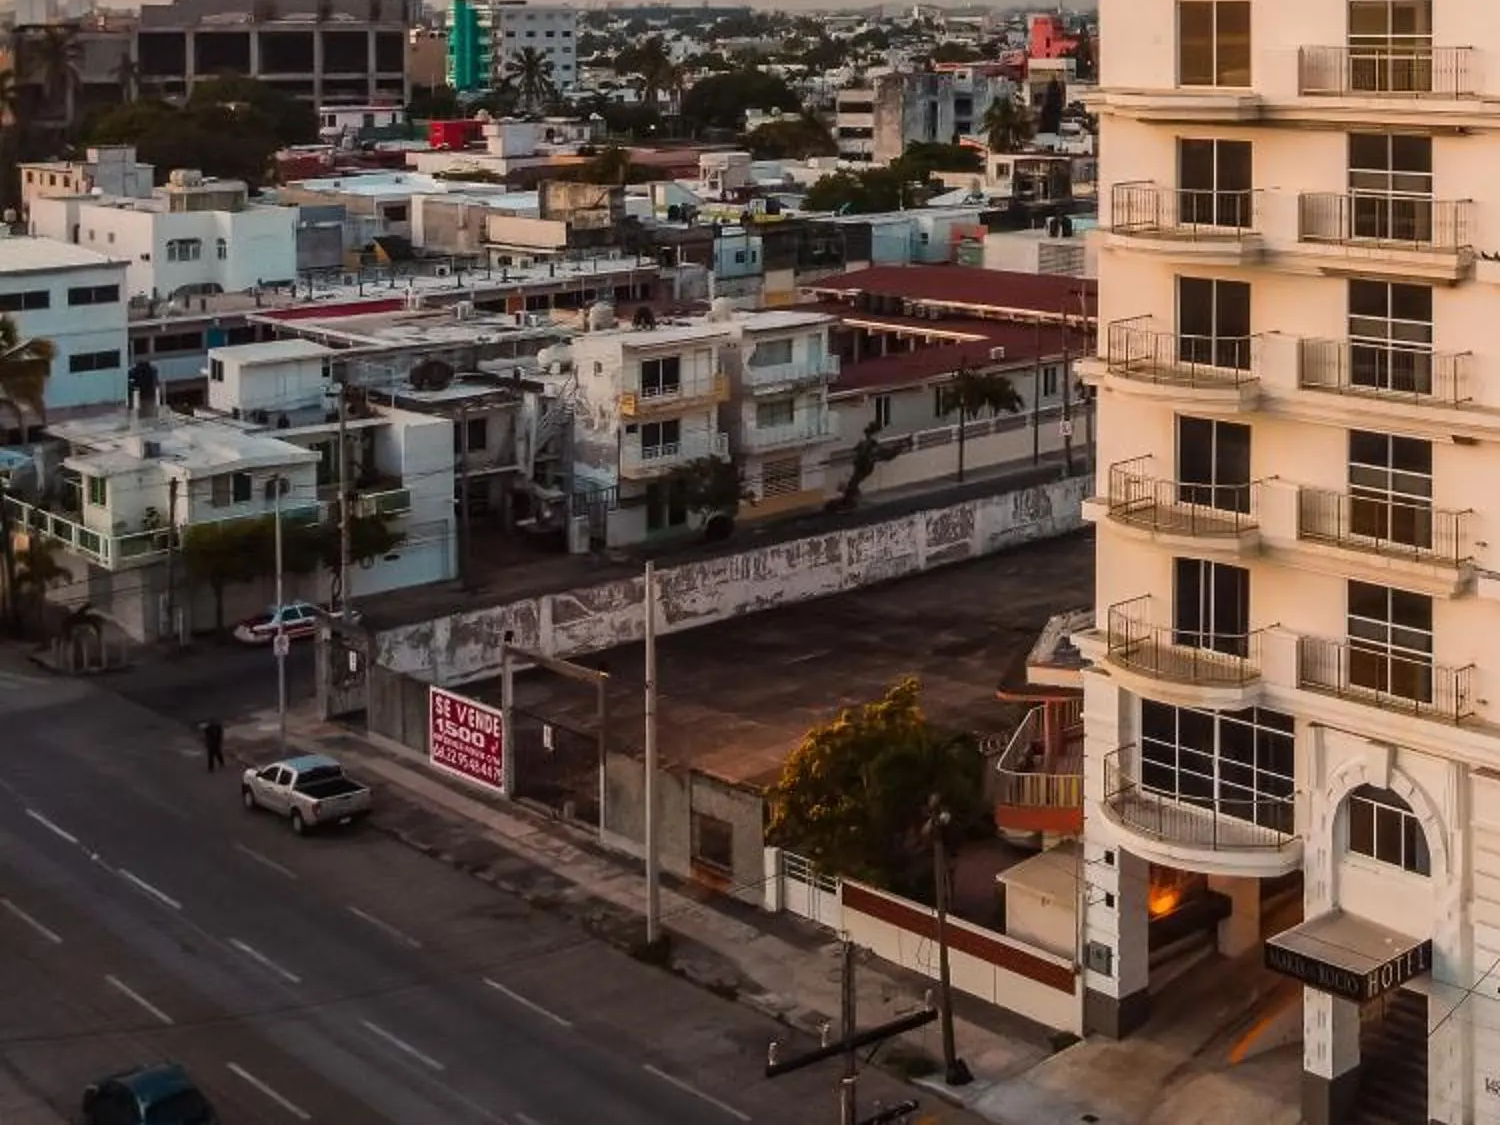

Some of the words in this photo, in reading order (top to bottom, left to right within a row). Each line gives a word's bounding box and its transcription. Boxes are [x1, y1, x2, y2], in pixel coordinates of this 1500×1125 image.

[434, 718, 485, 748] 1500
[435, 695, 451, 718] SE
[455, 703, 500, 738] VENDE
